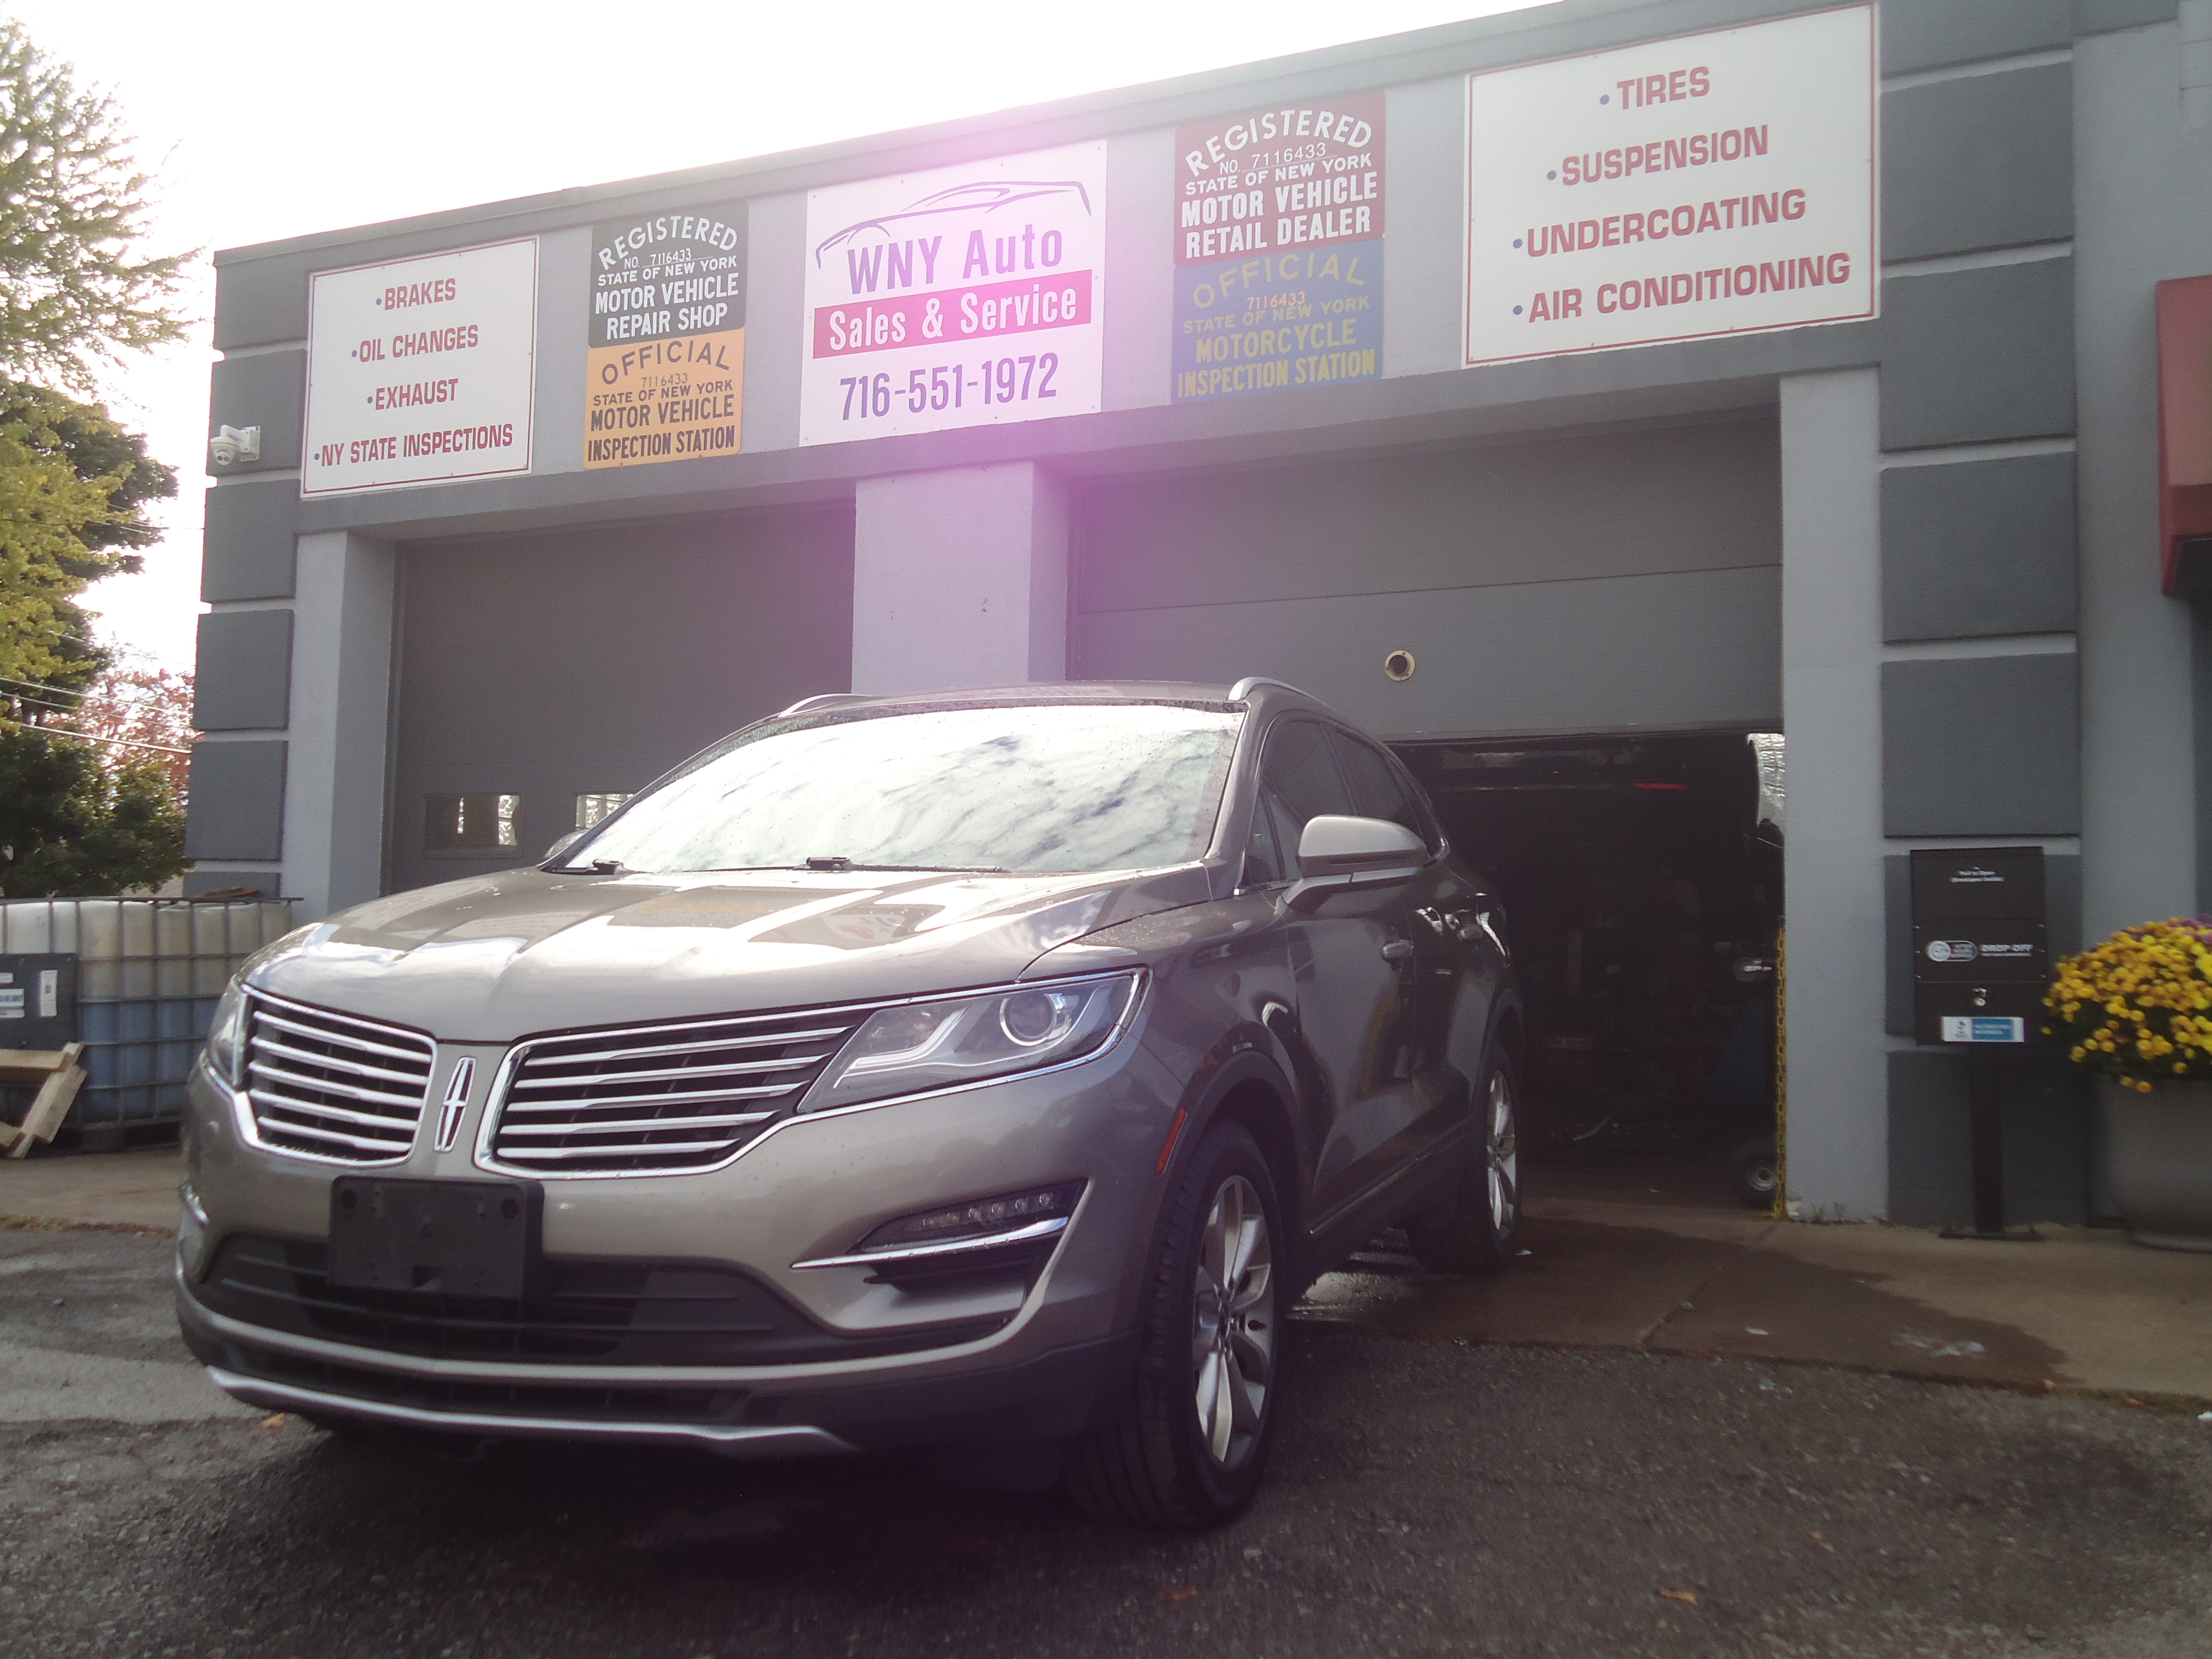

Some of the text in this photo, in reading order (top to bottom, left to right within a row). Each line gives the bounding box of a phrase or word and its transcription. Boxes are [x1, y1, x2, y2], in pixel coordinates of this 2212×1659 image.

[1617, 66, 1710, 110] TIRES
[1185, 110, 1372, 177] REGISTERED
[1220, 142, 1326, 175] NO. 7116433
[1562, 124, 1768, 186] SUSPENSION
[1186, 153, 1372, 195] STATE OF NEW YORK
[1182, 172, 1377, 227] MOTOR VEHICLE
[599, 216, 737, 270] REGISTERED
[1186, 206, 1371, 259] RETAIL DEALER
[1527, 188, 1806, 257] UNDERCOATING
[598, 256, 737, 286] STATE OF NEW YORK
[624, 248, 691, 269] NO. 7116433
[847, 224, 1062, 294] WNY Auto
[385, 278, 456, 310] BRAKES
[595, 273, 739, 314] MOTOR VEHICLE
[1194, 253, 1365, 308] OFFICIAL
[1247, 291, 1306, 310] 7116433
[1529, 252, 1850, 323] AIR CONDITIONING
[607, 303, 727, 339] REPAIR SHOP
[830, 284, 1076, 350] Sales & Service
[1183, 296, 1369, 333] STATE OF NEW YORK
[360, 325, 478, 362] OIL CHANGES
[1196, 318, 1356, 364] MOTORCYCLE
[602, 341, 729, 385] OFFICIAL
[641, 373, 688, 388] 7116433
[1178, 349, 1375, 398] INSPECTION STATION
[375, 379, 458, 410] EXHAUST
[593, 379, 733, 406] STATE OF NEW YORK
[840, 352, 1058, 420] 716-551-1972
[591, 394, 734, 431] MOTOR VEHICLE
[322, 423, 513, 466] NY STATE INSPECTIONS
[588, 426, 735, 461] INSPECTION STATION
